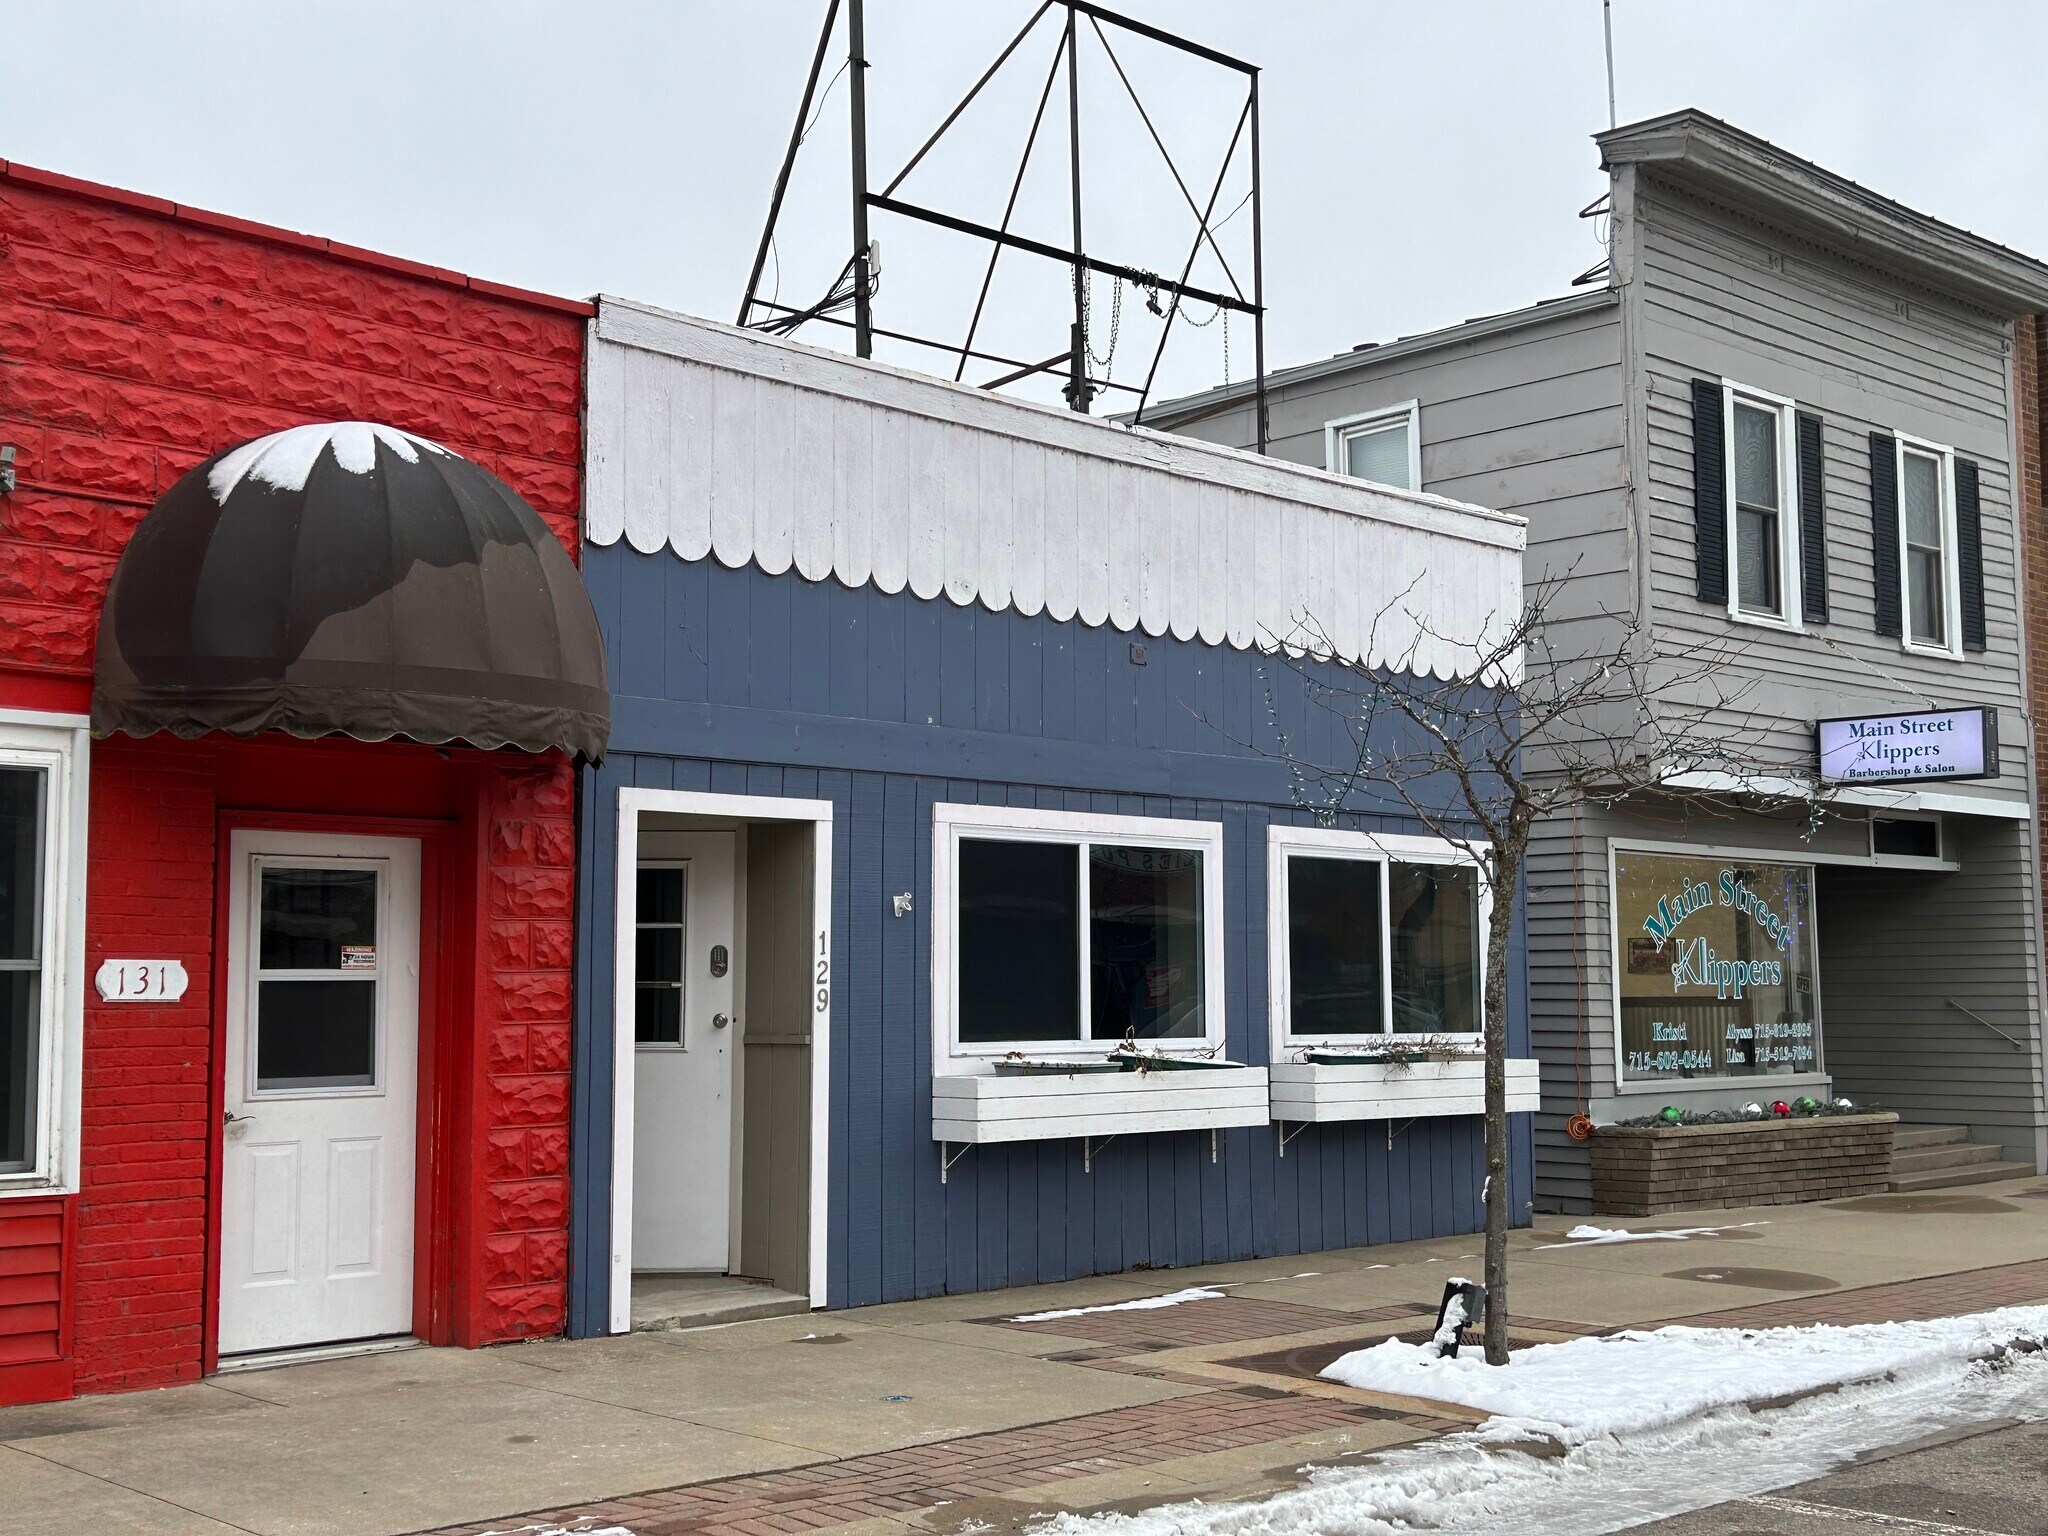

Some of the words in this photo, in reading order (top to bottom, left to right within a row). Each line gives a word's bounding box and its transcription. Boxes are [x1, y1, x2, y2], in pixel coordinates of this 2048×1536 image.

[1849, 721, 1894, 738] Main
[1900, 718, 1954, 735] Street
[1857, 739, 1940, 763] Klippers
[1849, 766, 1911, 778] Barbershop
[1913, 765, 1922, 774] &
[1925, 763, 1956, 773] Salon
[1643, 877, 1713, 953] Main
[1718, 869, 1791, 951] Street
[816, 930, 829, 1013] 129
[1671, 937, 1781, 999] Klippers
[118, 966, 165, 996] 131
[1797, 976, 1810, 992] OPEN
[1652, 1021, 1688, 1041] Kristi
[1725, 1023, 1753, 1044] Alyssa
[1629, 1049, 1712, 1071] 715-602-0544
[1726, 1047, 1746, 1064] Lisa
